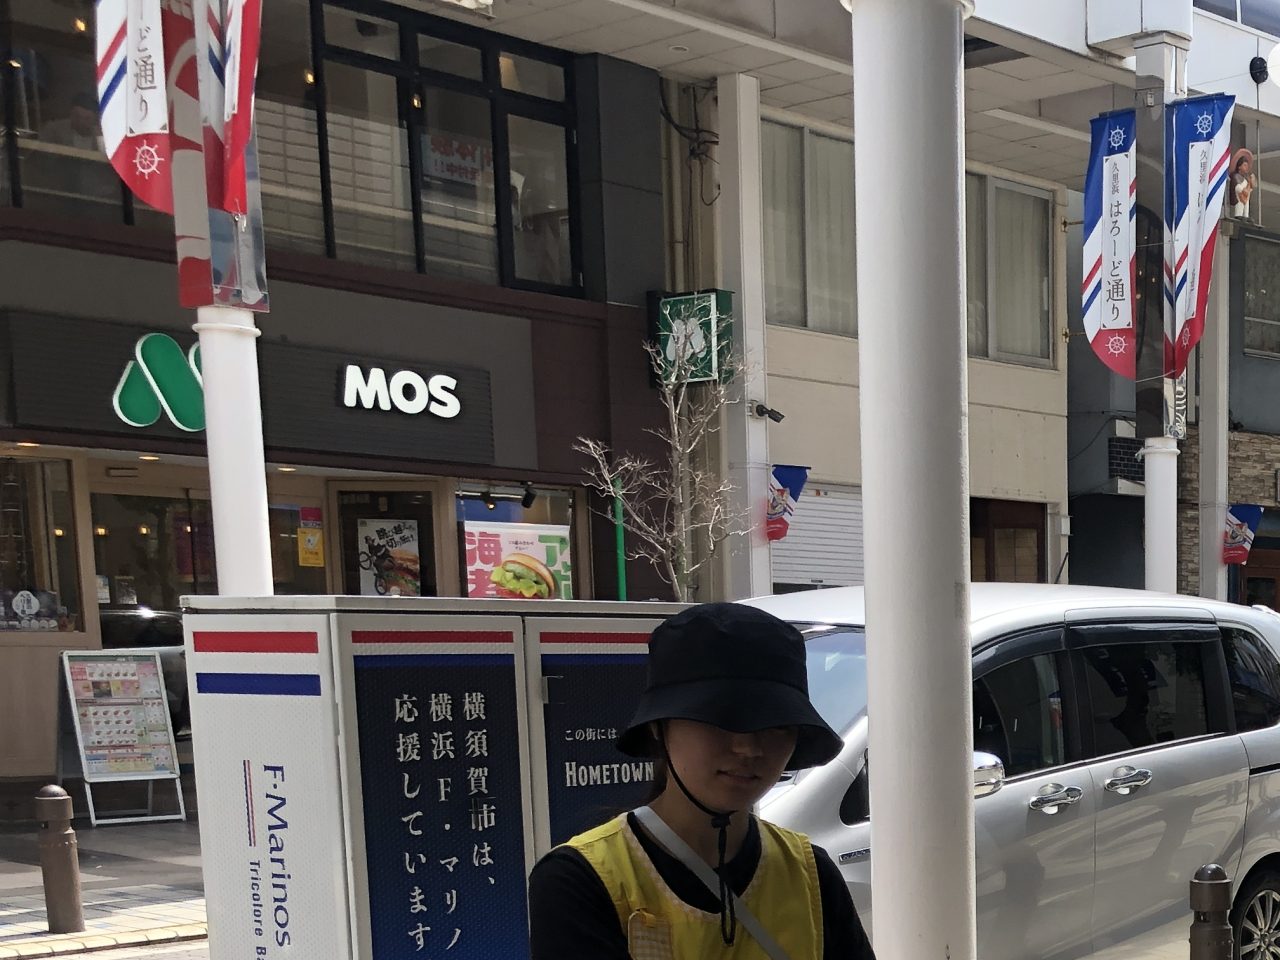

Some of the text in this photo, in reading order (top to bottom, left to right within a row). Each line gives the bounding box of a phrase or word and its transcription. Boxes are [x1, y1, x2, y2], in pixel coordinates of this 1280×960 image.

[1106, 162, 1126, 322] 久里浜 はろーど通り
[343, 364, 461, 419] MOS
[462, 692, 496, 885] 横須賀市は、
[564, 761, 655, 787] HOMETOWN
[249, 859, 264, 937] Tricolore
